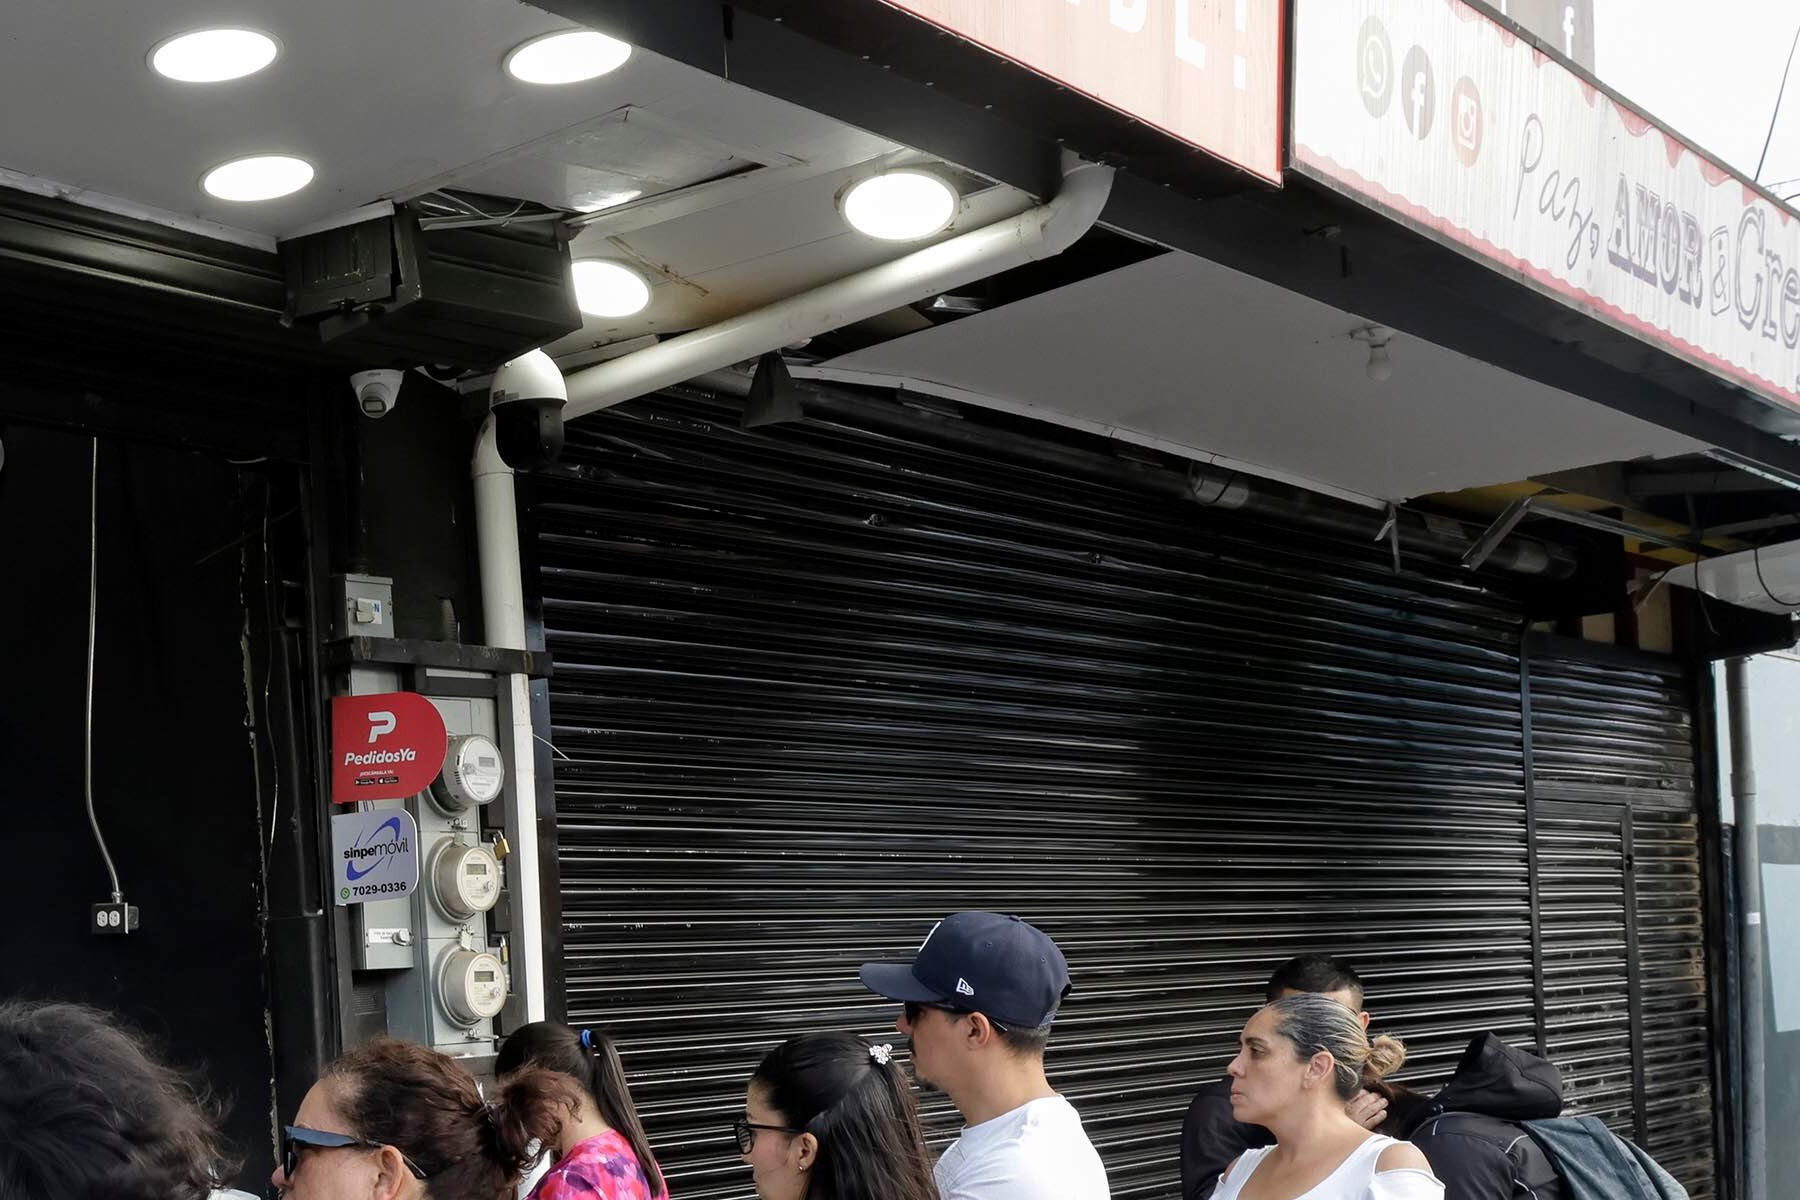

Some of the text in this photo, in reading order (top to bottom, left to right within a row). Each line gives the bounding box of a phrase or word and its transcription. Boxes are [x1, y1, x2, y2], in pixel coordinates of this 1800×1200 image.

[1607, 173, 1703, 310] AMOR
[344, 748, 416, 766] PedidosYa
[344, 837, 408, 859] sinpemóvil
[352, 881, 406, 896] 7029-0336
